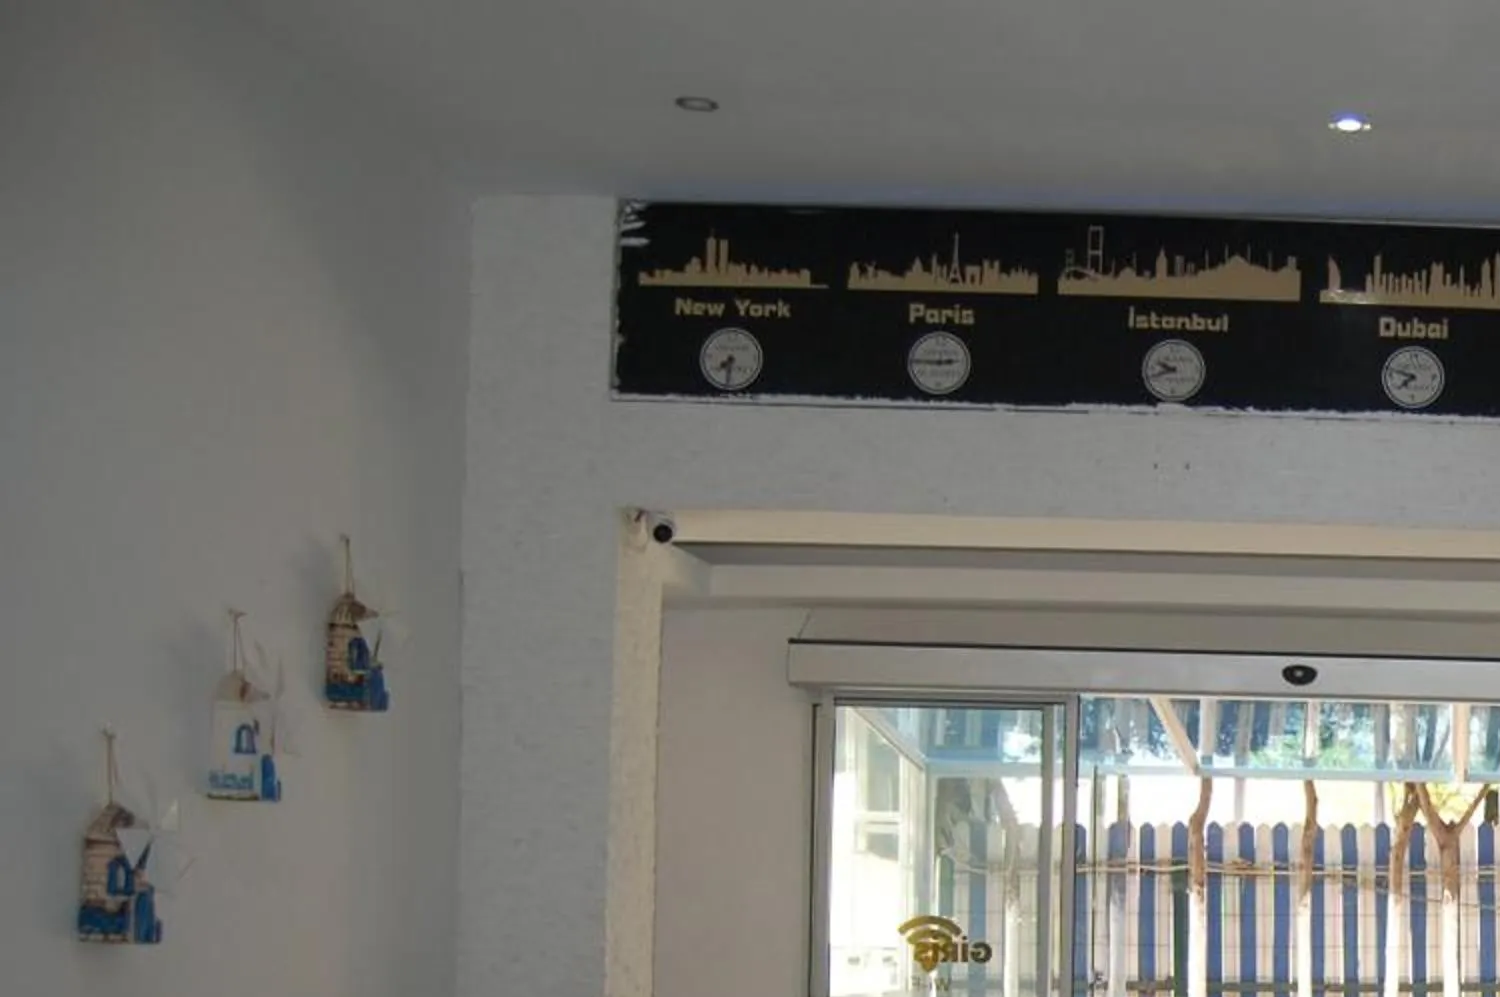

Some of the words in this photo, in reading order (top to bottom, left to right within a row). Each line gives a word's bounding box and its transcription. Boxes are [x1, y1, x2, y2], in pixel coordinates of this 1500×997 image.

[675, 298, 726, 317] New
[735, 299, 790, 318] York
[909, 303, 975, 325] Paris
[1378, 316, 1449, 340] Dubai
